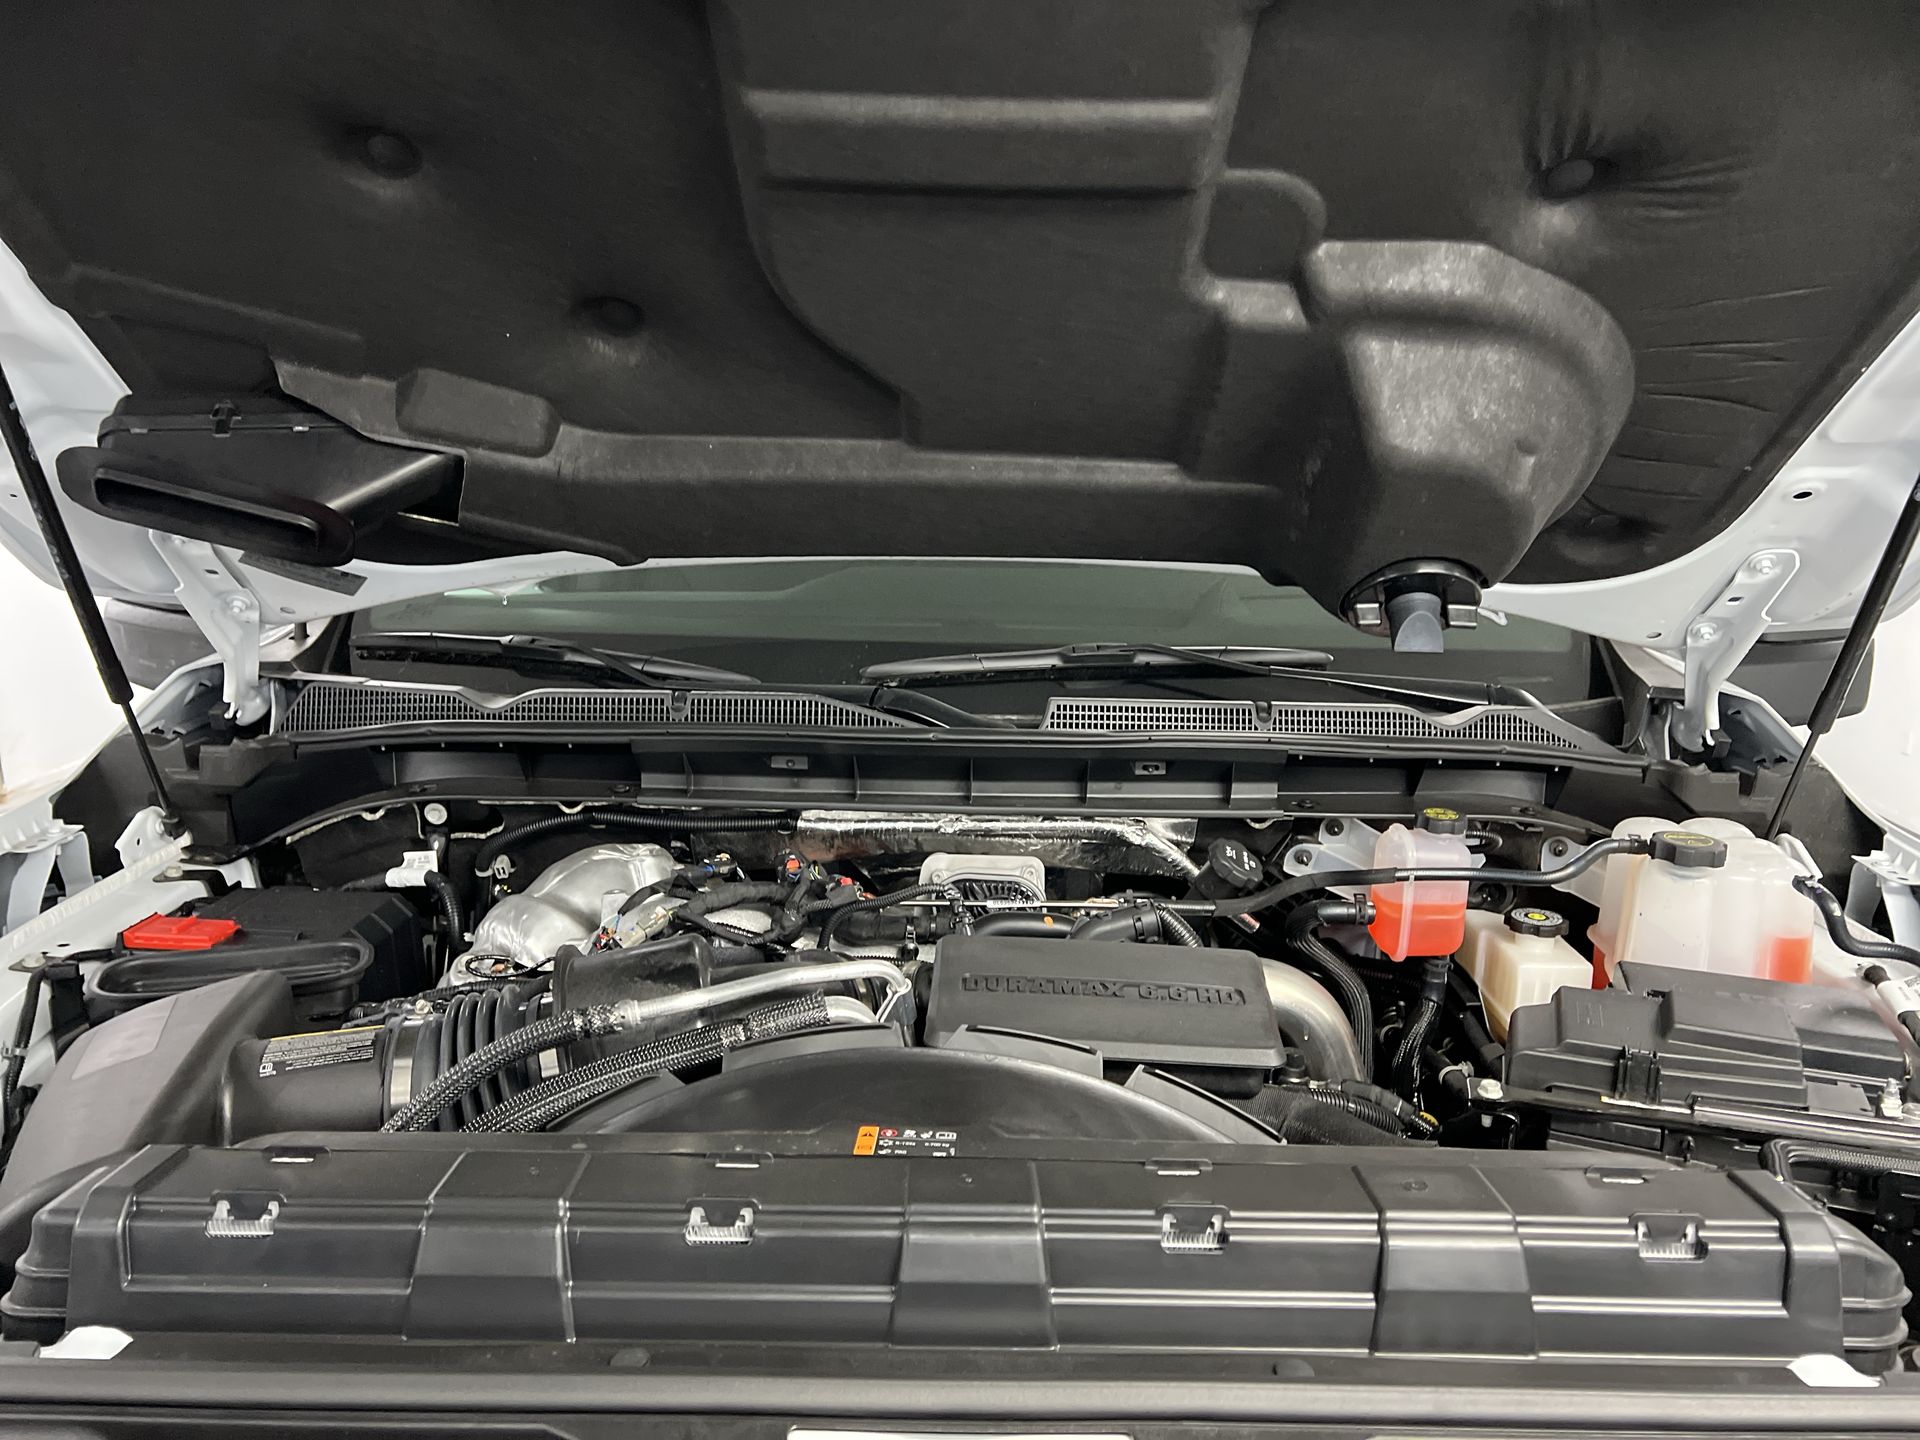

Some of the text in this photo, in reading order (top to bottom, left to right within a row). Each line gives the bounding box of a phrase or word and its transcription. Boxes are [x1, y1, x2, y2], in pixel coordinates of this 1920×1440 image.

[963, 976, 1243, 1004] DURAMAX 6.6 HD
